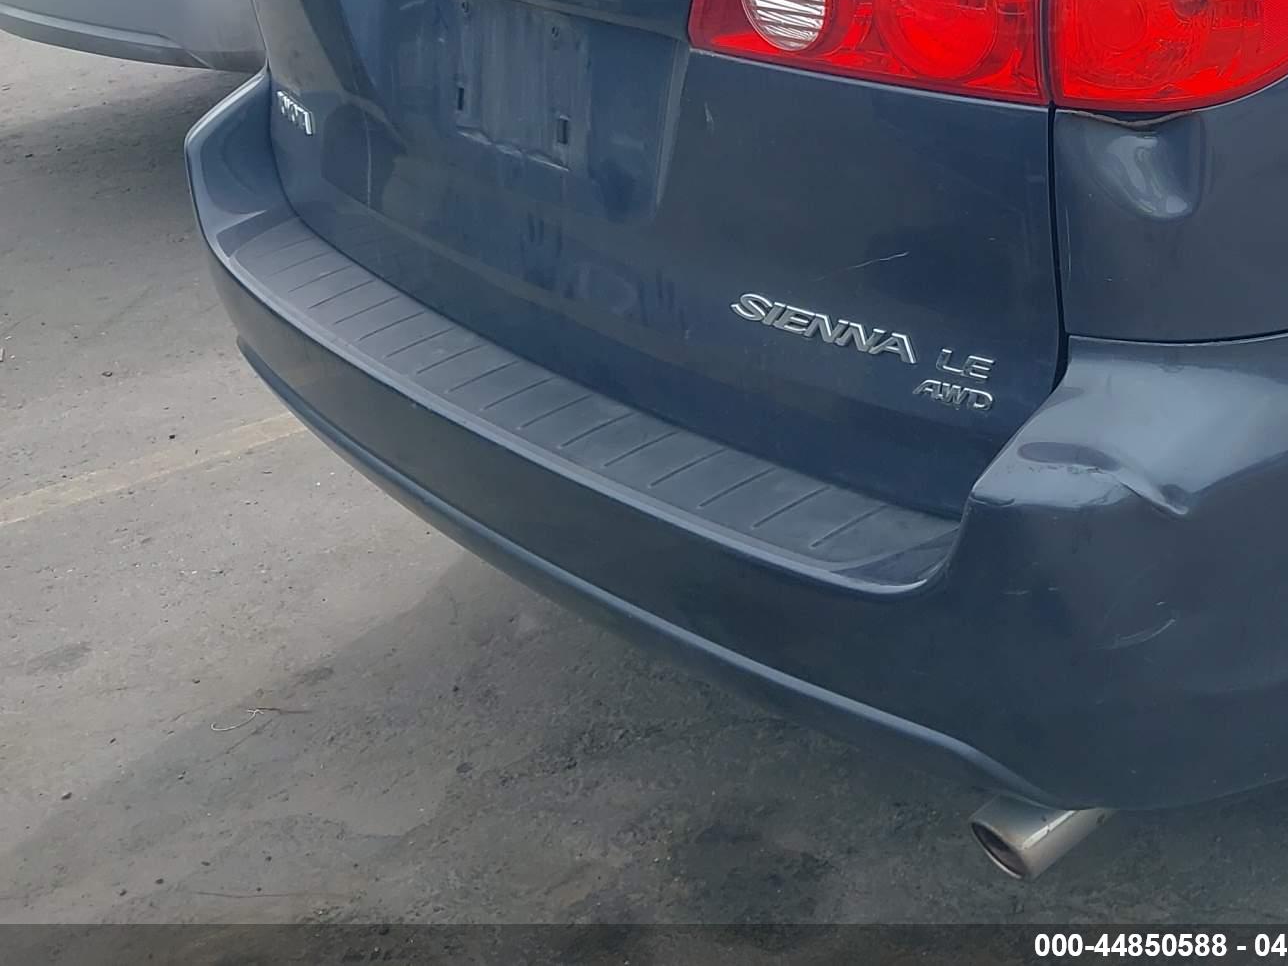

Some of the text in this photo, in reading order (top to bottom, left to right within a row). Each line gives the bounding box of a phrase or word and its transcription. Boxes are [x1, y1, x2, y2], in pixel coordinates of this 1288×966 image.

[730, 291, 918, 365] SIENNA
[936, 347, 996, 380] LE
[912, 378, 996, 411] AWD
